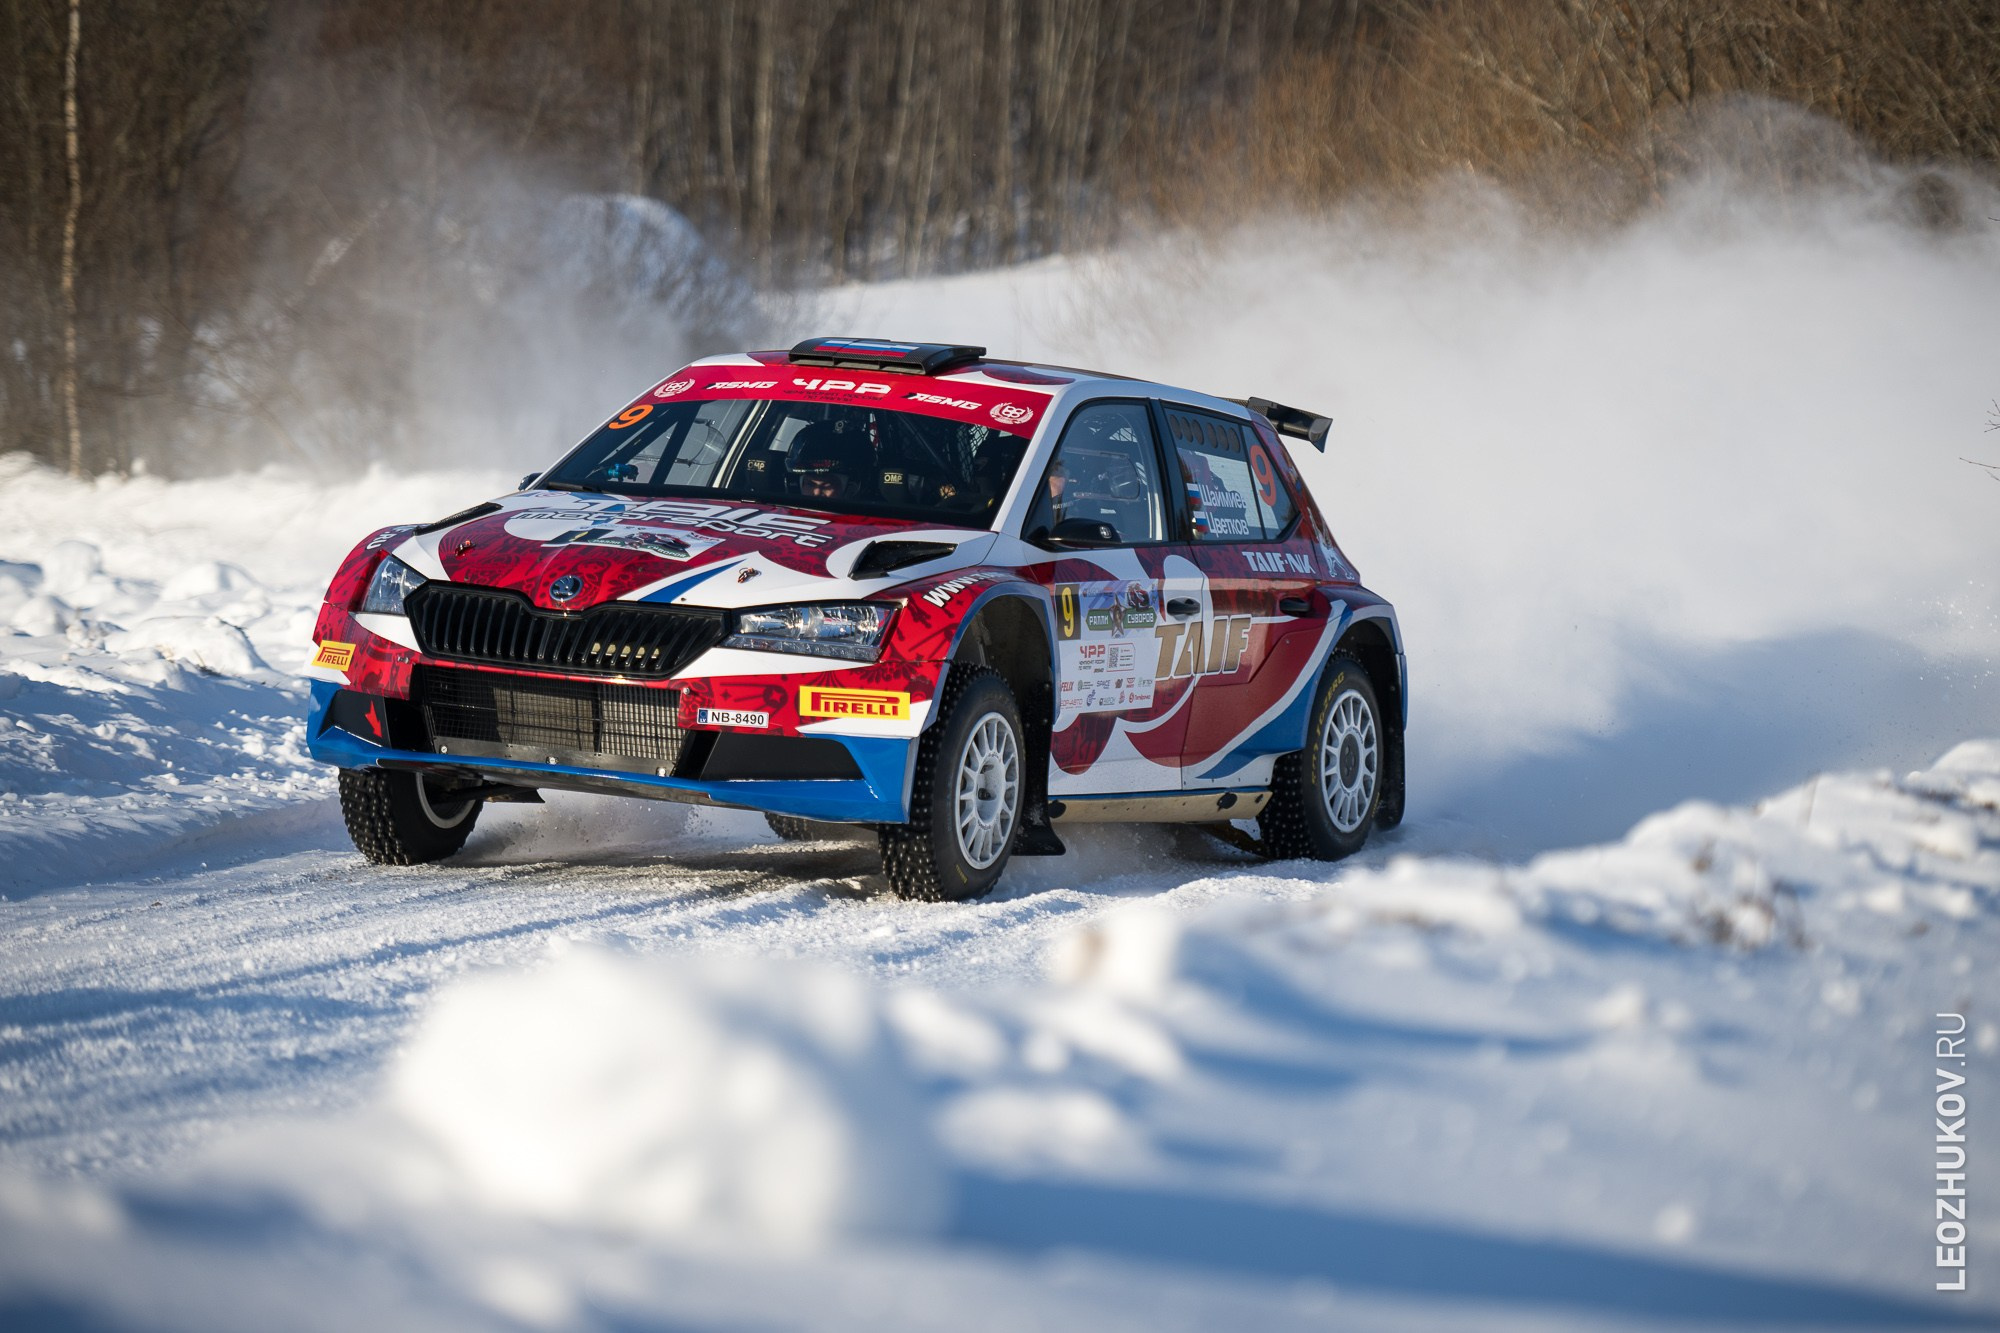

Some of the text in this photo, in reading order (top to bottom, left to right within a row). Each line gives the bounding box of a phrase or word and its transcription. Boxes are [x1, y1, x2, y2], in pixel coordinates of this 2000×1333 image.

[707, 381, 778, 390] ASMG
[792, 378, 892, 395] ЧРР
[907, 392, 982, 410] ASMG
[608, 404, 654, 430] 9
[883, 473, 903, 483] OMP
[1250, 444, 1277, 507] 9
[1205, 511, 1250, 538] Цветков
[1061, 586, 1075, 638] 9
[1127, 612, 1154, 624] СУВОРОВ
[317, 646, 351, 666] PIRELLI
[1154, 616, 1252, 679] TAIF
[1060, 681, 1075, 691] FELIX
[811, 692, 900, 716] PIRELLI
[711, 711, 765, 725] NB-8490
